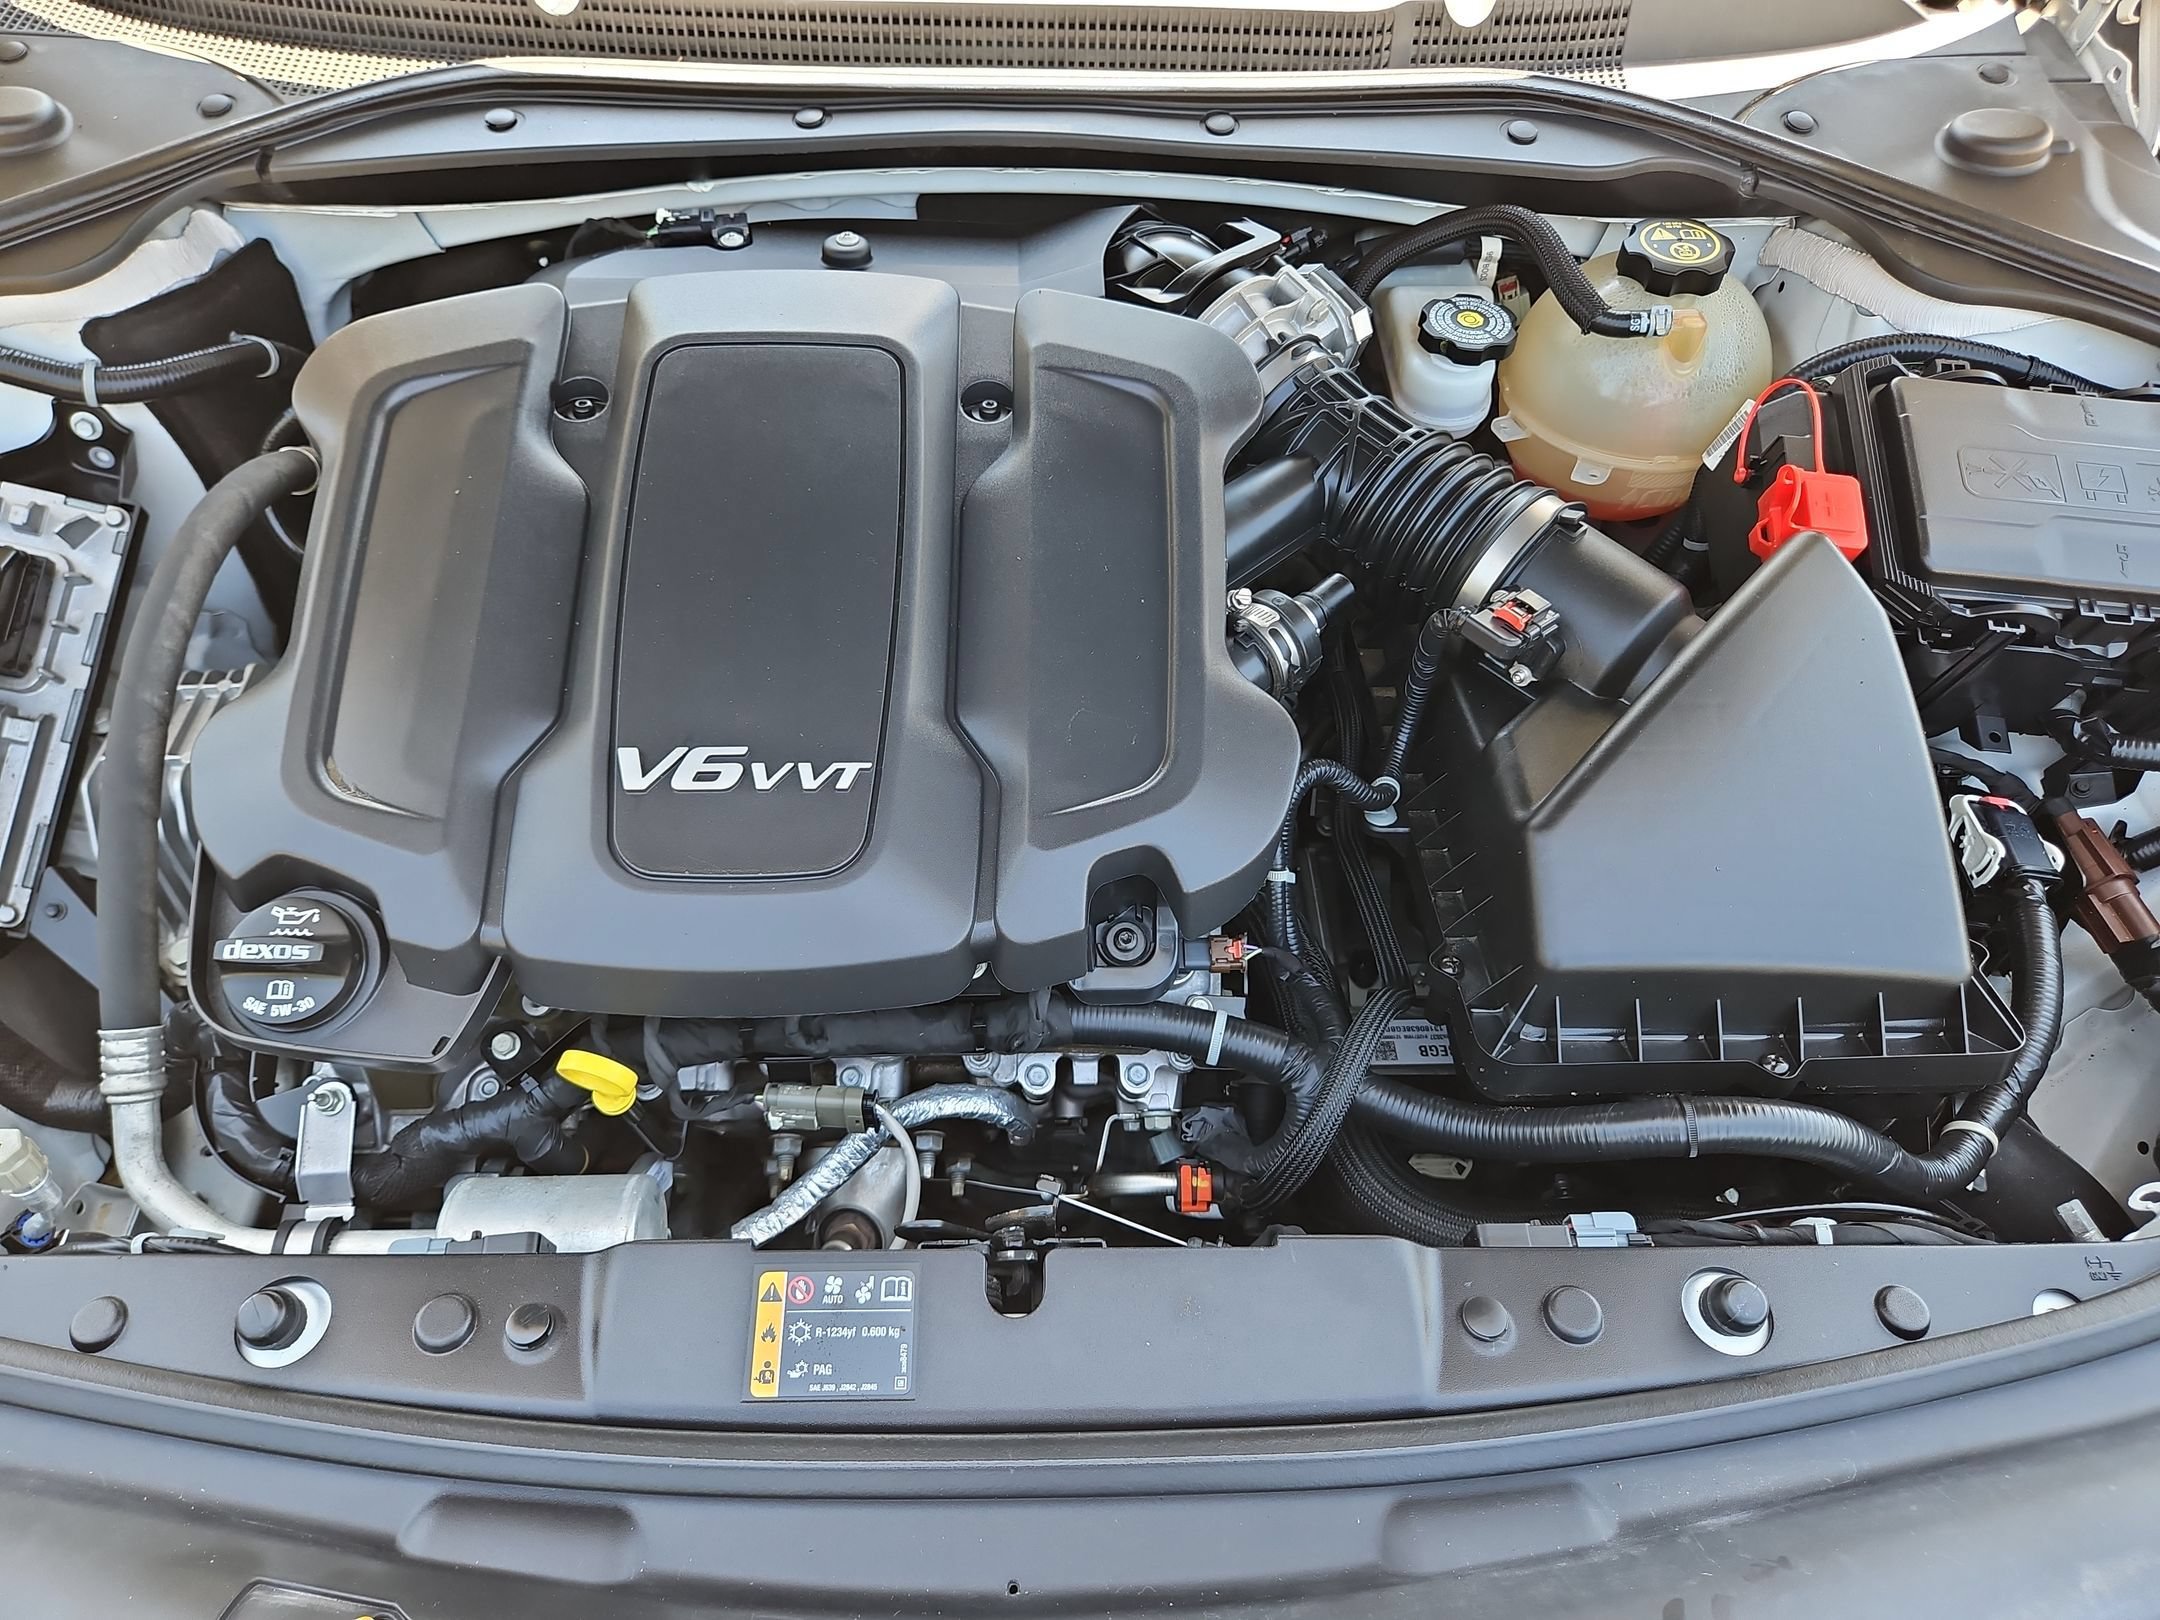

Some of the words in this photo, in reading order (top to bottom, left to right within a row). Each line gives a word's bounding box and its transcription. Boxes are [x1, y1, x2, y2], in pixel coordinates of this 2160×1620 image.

[617, 746, 749, 792] V6
[751, 762, 873, 791] VVT
[222, 940, 315, 960] dexos
[242, 996, 268, 1016] SAE
[270, 996, 315, 1017] 5W-30
[822, 1295, 843, 1304] AUTO
[815, 1326, 856, 1340] R-1234yf
[862, 1326, 886, 1337] 0.600
[888, 1326, 900, 1338] kg
[813, 1364, 833, 1375] PAG
[809, 1384, 821, 1392] SAE
